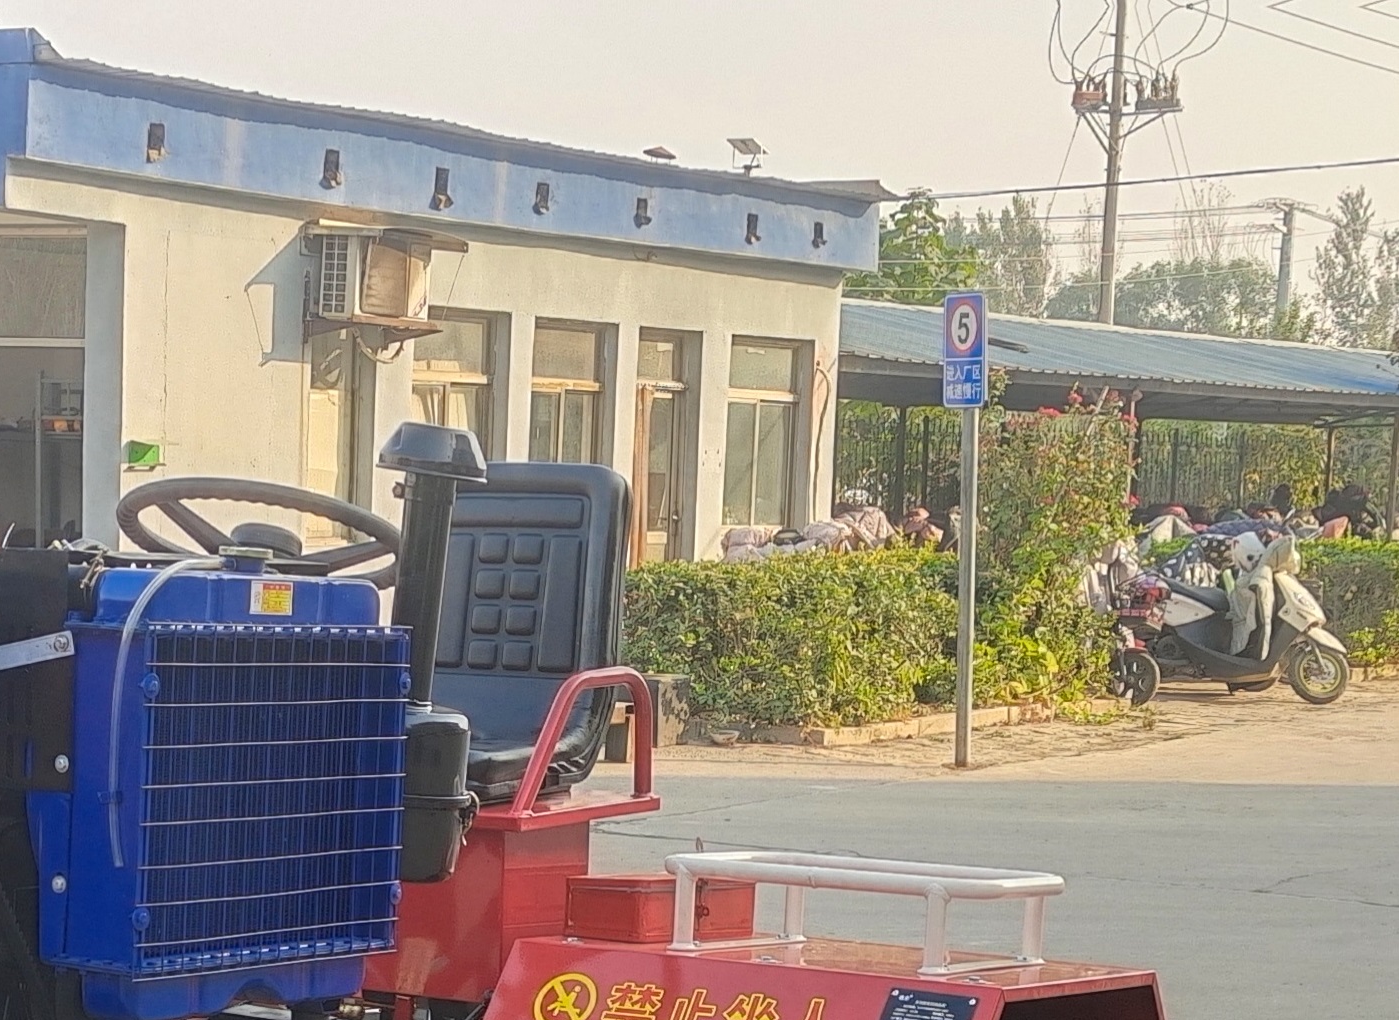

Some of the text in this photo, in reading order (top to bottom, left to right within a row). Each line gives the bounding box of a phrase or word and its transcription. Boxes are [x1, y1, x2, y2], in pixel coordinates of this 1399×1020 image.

[957, 312, 970, 345] 5
[946, 364, 981, 381] 进入厂区
[946, 382, 981, 400] 减速慢行
